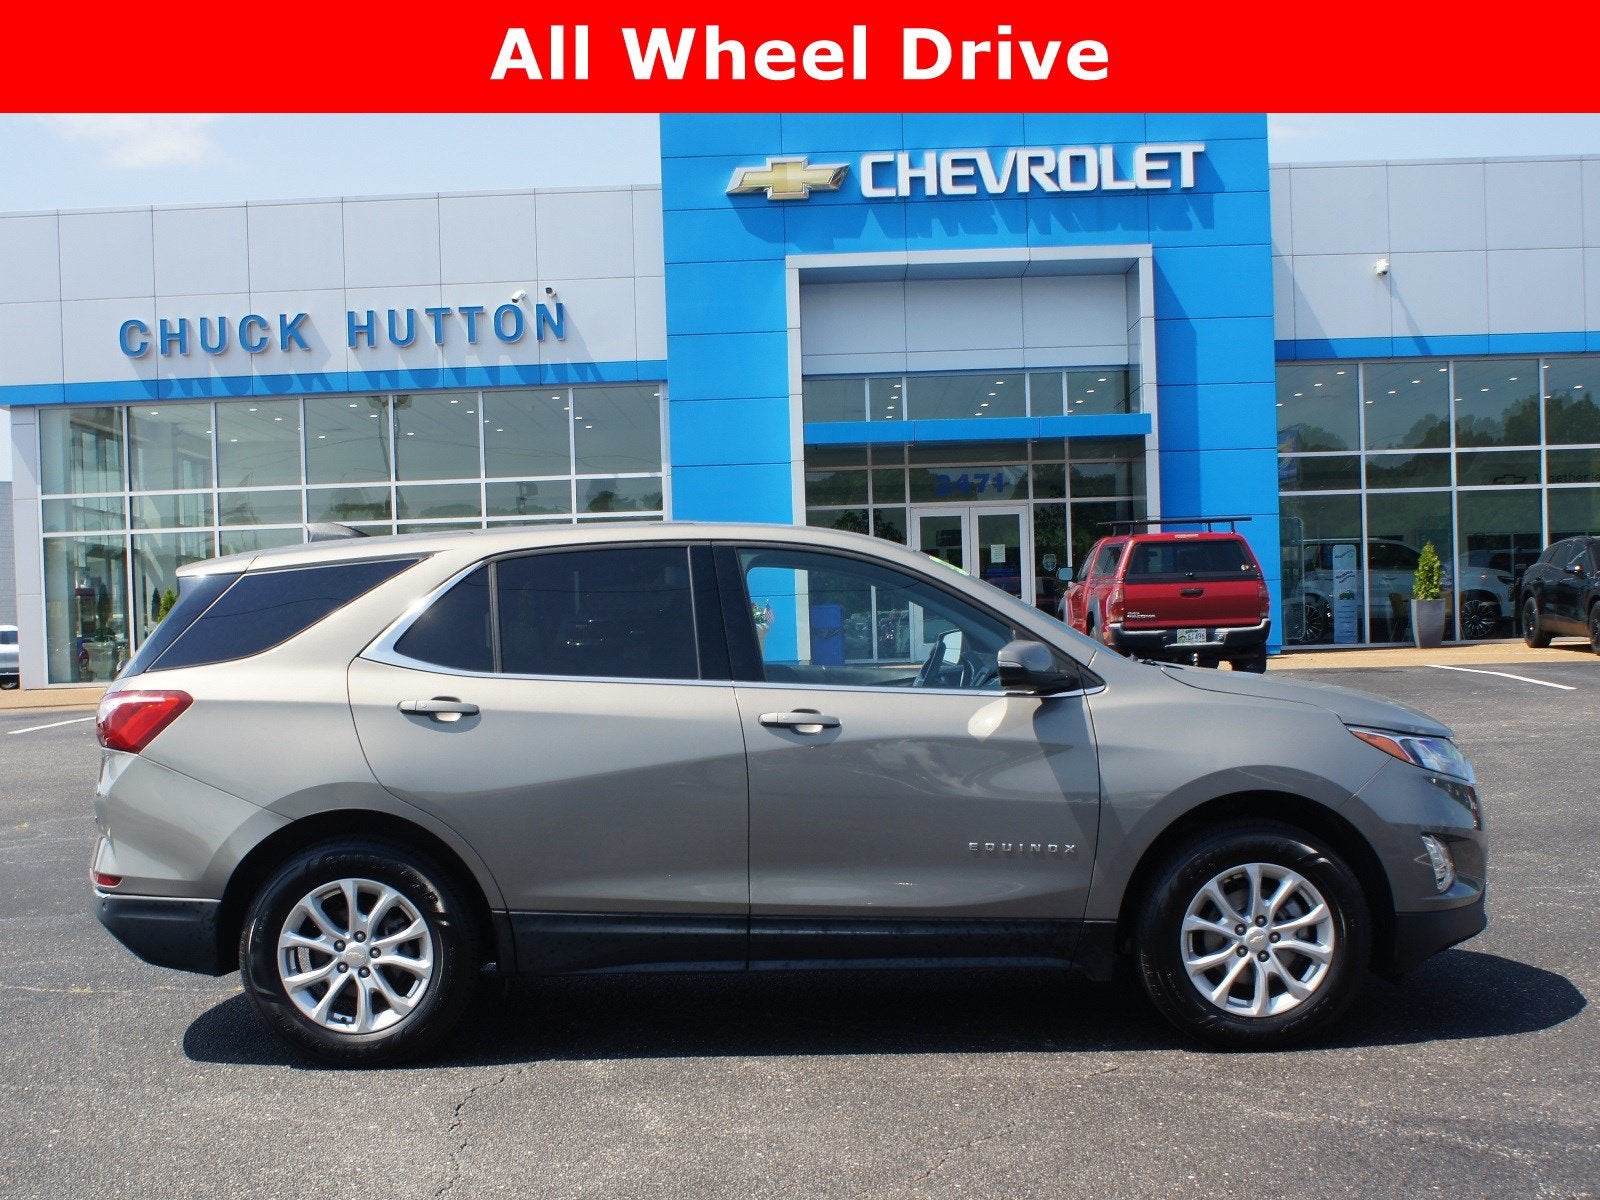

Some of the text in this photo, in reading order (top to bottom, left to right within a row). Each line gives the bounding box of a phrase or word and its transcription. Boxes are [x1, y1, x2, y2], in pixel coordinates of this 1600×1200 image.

[860, 143, 1205, 198] CHEVROLET
[119, 301, 567, 359] CHUCK HUTTON
[935, 472, 1006, 496] 2471
[968, 842, 1075, 853] EQUINOX
